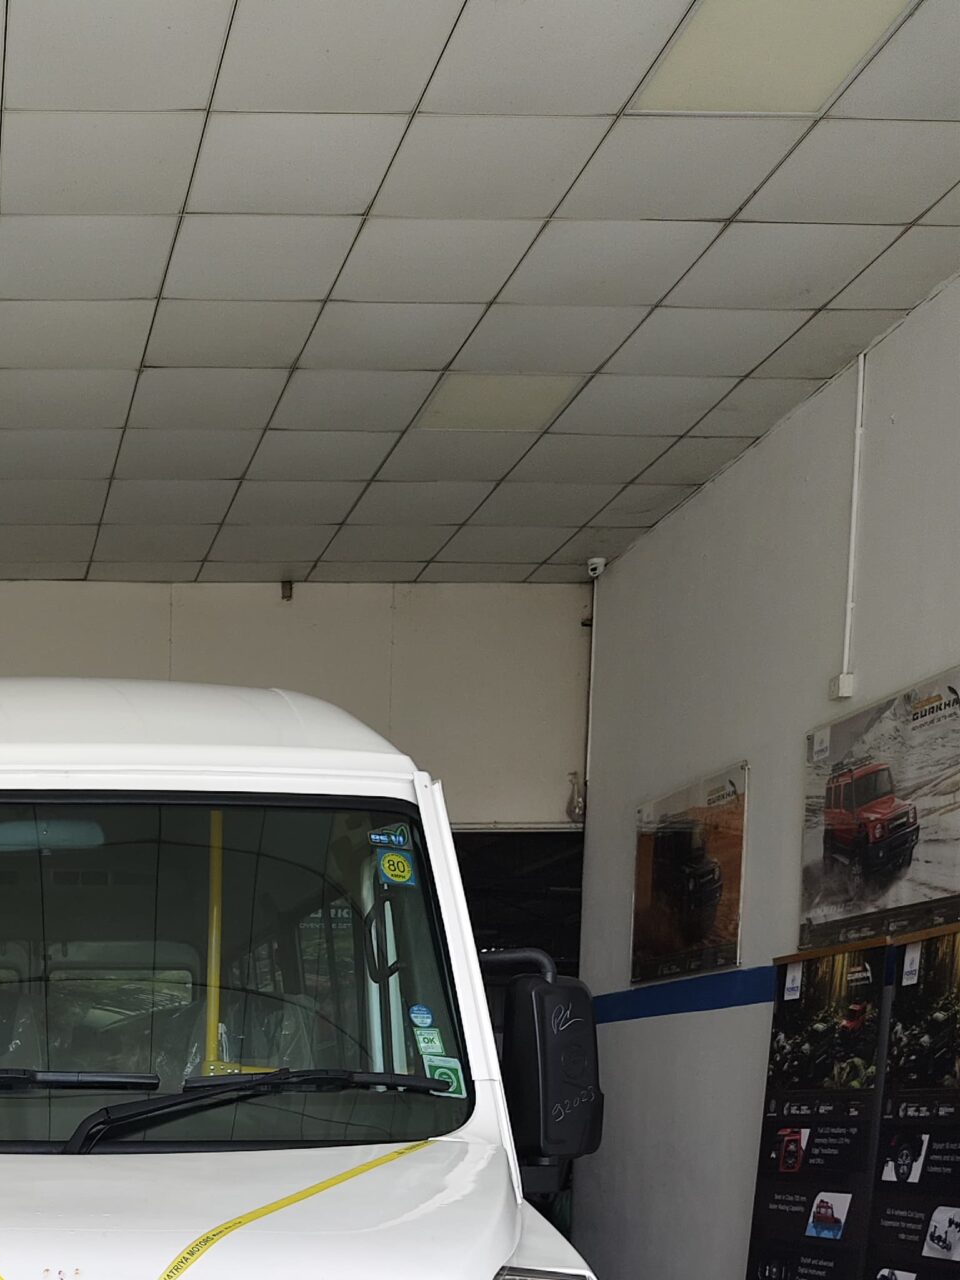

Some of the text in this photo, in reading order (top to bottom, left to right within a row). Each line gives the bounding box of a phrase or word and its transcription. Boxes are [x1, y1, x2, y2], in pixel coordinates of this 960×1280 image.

[387, 859, 406, 874] 80
[422, 1036, 436, 1045] OK
[186, 1235, 214, 1257] MOTORS
